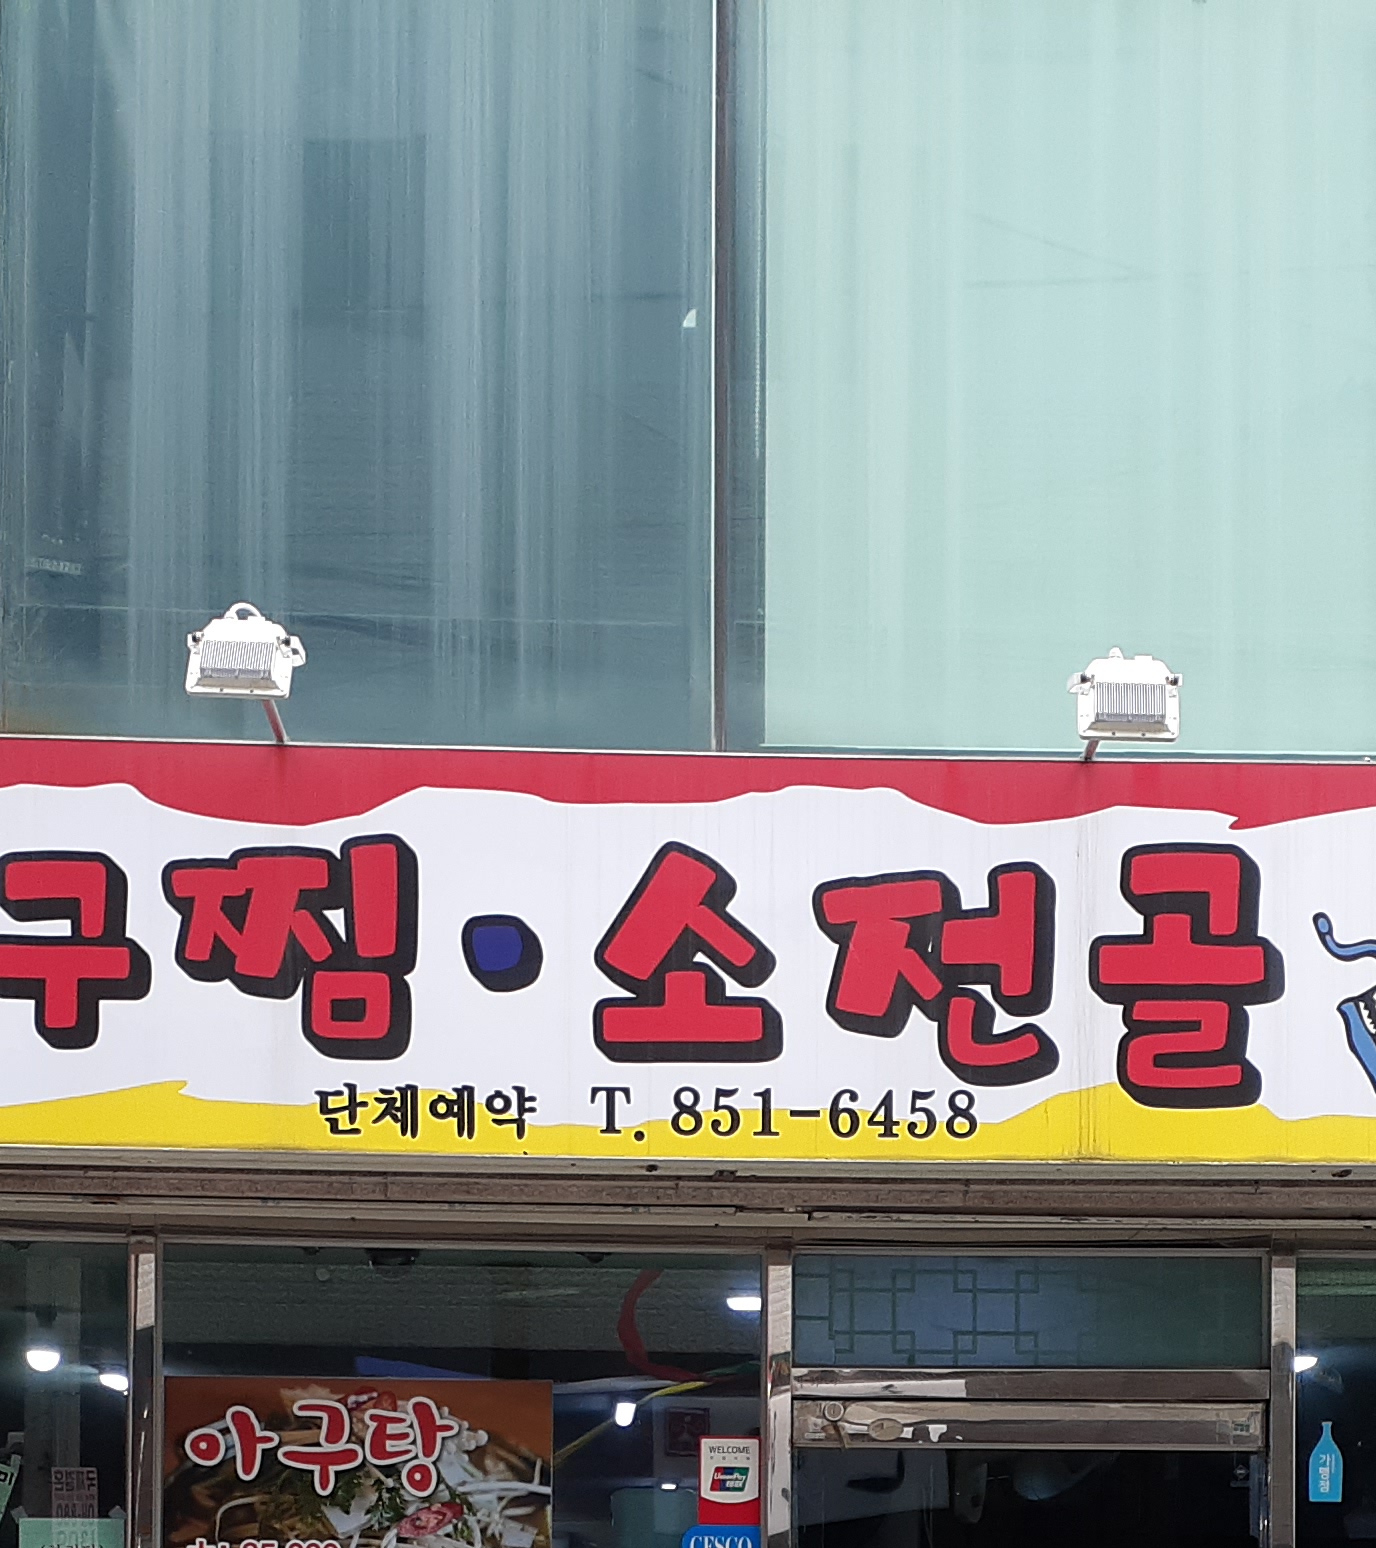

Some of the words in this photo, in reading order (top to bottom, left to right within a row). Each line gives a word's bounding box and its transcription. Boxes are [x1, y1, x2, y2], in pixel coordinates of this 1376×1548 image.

[593, 840, 1286, 1109] 소전골
[314, 1082, 539, 1141] 단체예약
[590, 1086, 648, 1144] T.
[670, 1085, 981, 1141] 851-6458
[184, 1395, 460, 1497] 아구탕
[708, 1445, 751, 1455] WELCOME
